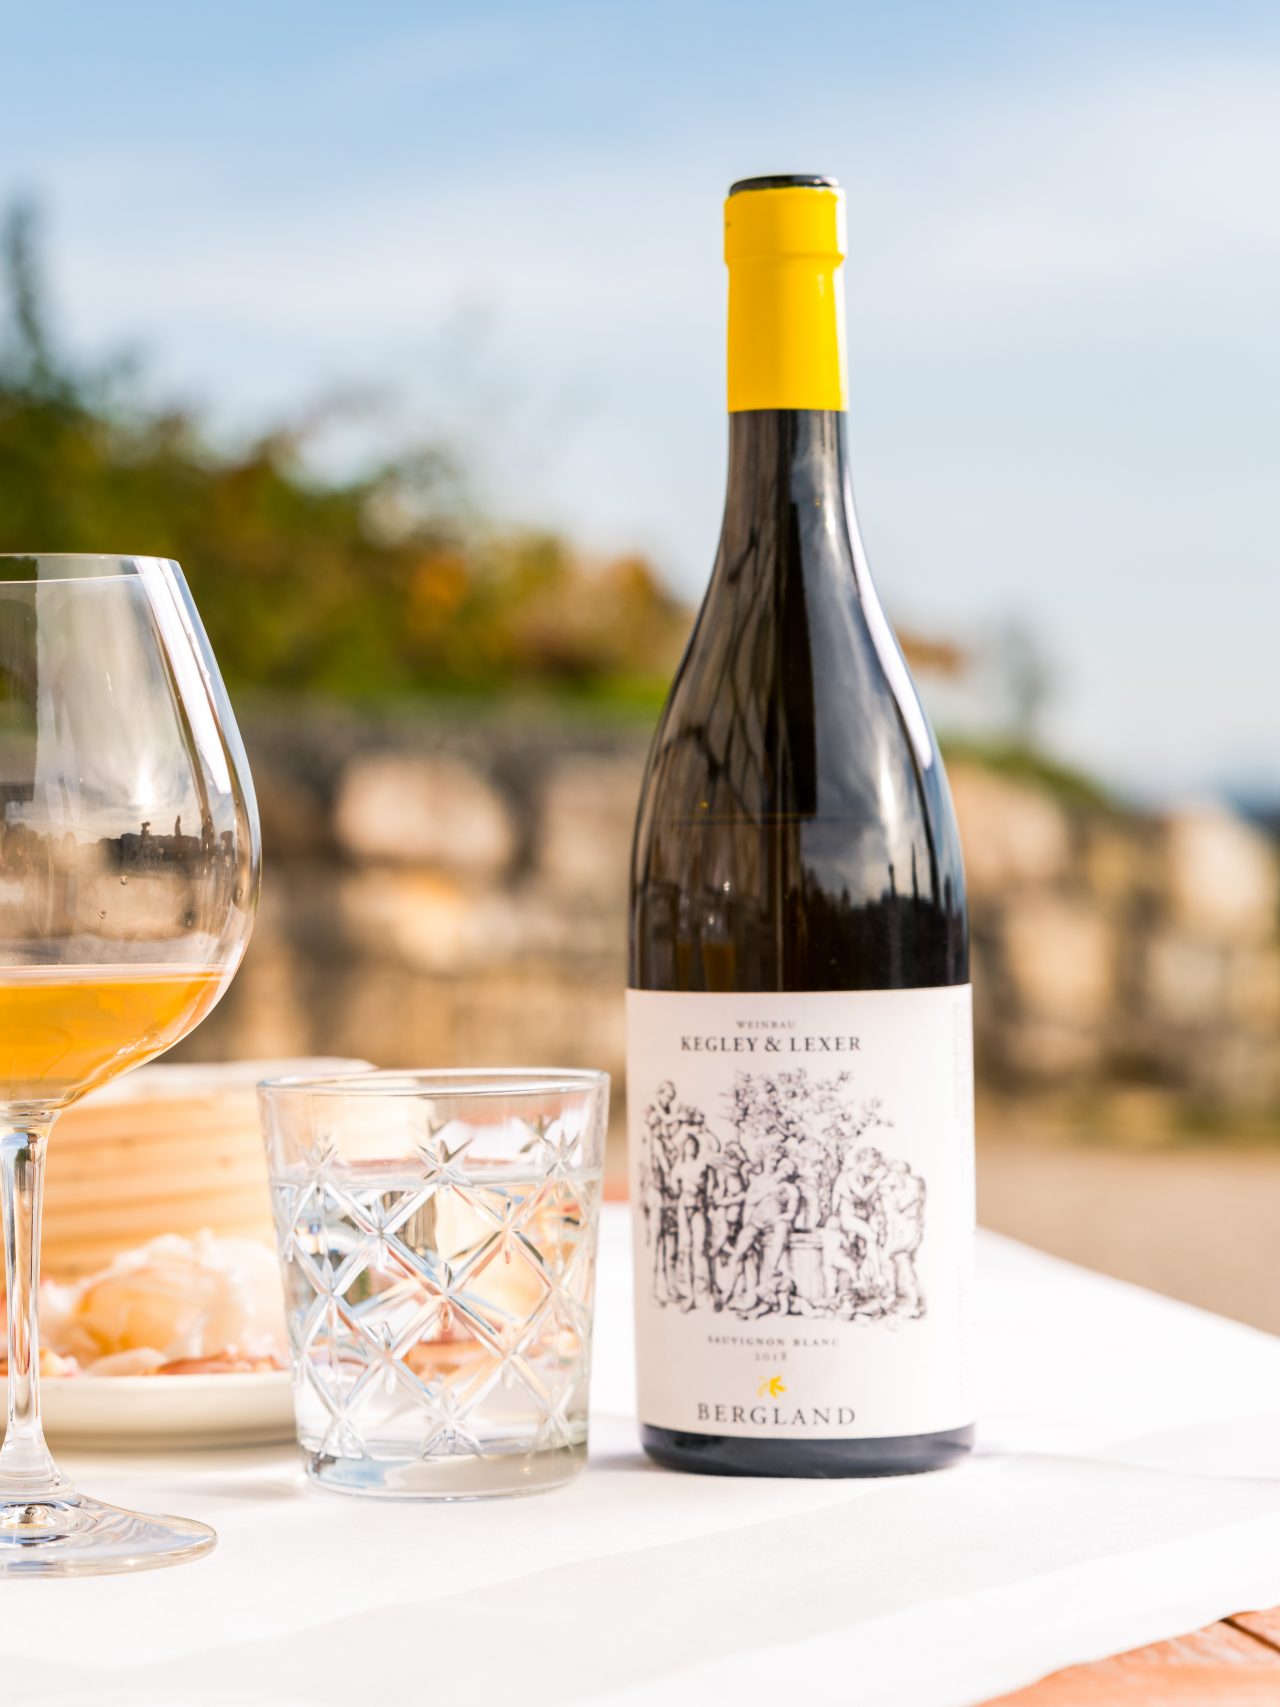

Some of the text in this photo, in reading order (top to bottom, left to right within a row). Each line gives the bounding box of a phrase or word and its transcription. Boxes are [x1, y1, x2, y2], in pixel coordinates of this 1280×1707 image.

[736, 1020, 797, 1030] WEINBAU
[681, 1036, 862, 1052] KEGLEY & LEXER
[707, 1335, 841, 1347] SAUVIGNON BLANC
[697, 1402, 857, 1426] BERGLAND
